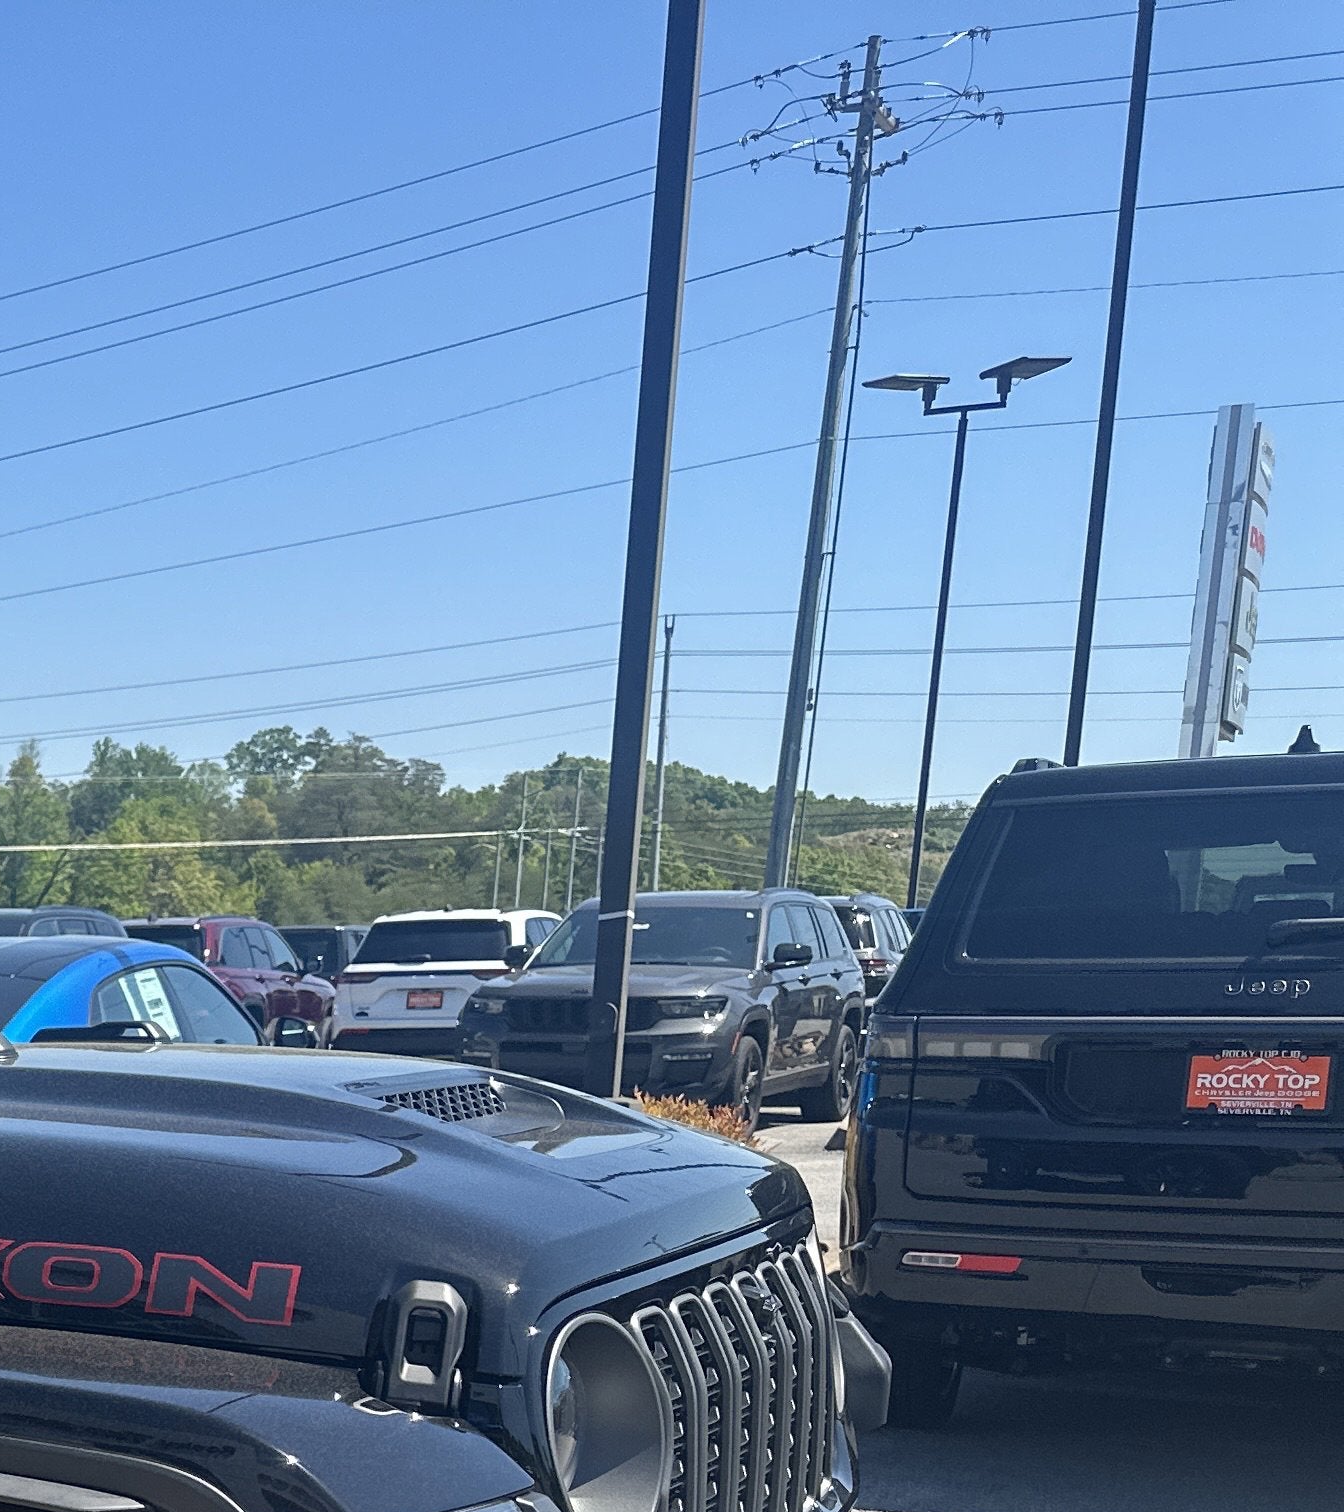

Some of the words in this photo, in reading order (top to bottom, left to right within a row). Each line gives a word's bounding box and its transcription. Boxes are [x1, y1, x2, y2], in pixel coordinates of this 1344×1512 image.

[1225, 976, 1310, 998] Jeep
[1222, 1050, 1255, 1058] ROCKY
[1260, 1050, 1279, 1058] TOP
[1196, 1073, 1270, 1088] ROCKY
[1274, 1074, 1321, 1089] TOP
[1194, 1089, 1253, 1097] CHRYSLER
[1254, 1089, 1276, 1098] Jeep
[1280, 1101, 1292, 1109] TN
[1280, 1108, 1292, 1116] TN
